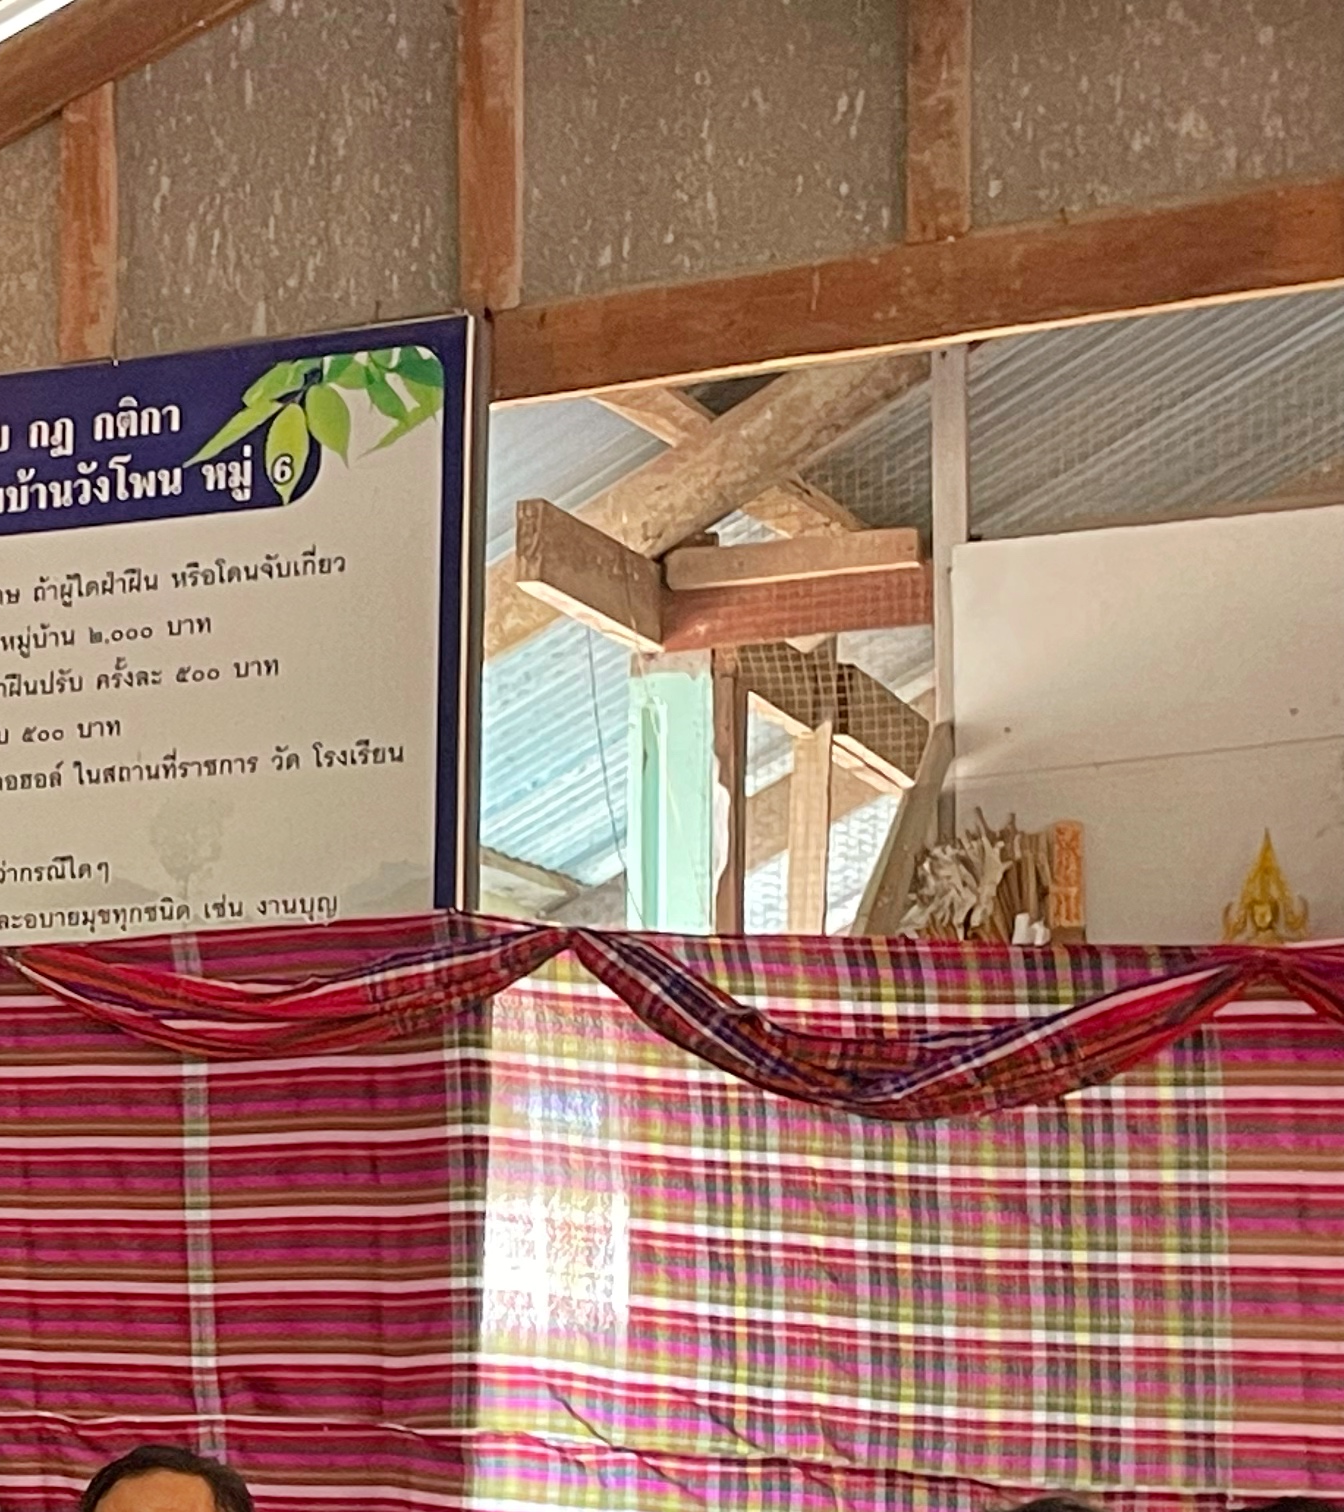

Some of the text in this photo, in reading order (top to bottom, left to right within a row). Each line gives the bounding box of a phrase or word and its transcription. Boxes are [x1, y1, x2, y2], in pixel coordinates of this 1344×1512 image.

[92, 396, 181, 441] กติกา
[201, 443, 253, 502] หมู่
[272, 456, 293, 484] 6
[171, 544, 346, 590] หรือโดนจับเกี่ยว
[167, 615, 212, 637] บาท
[96, 656, 163, 691] ครั้งละ
[175, 665, 221, 683] ๕๐๐
[233, 657, 279, 679] บาท
[21, 724, 65, 744] ๕๐๐
[77, 718, 121, 739] บาท
[270, 744, 301, 772] วัด
[311, 738, 405, 769] โรงเรียน
[203, 893, 244, 920] เช่น
[256, 895, 338, 923] งานบุญ
